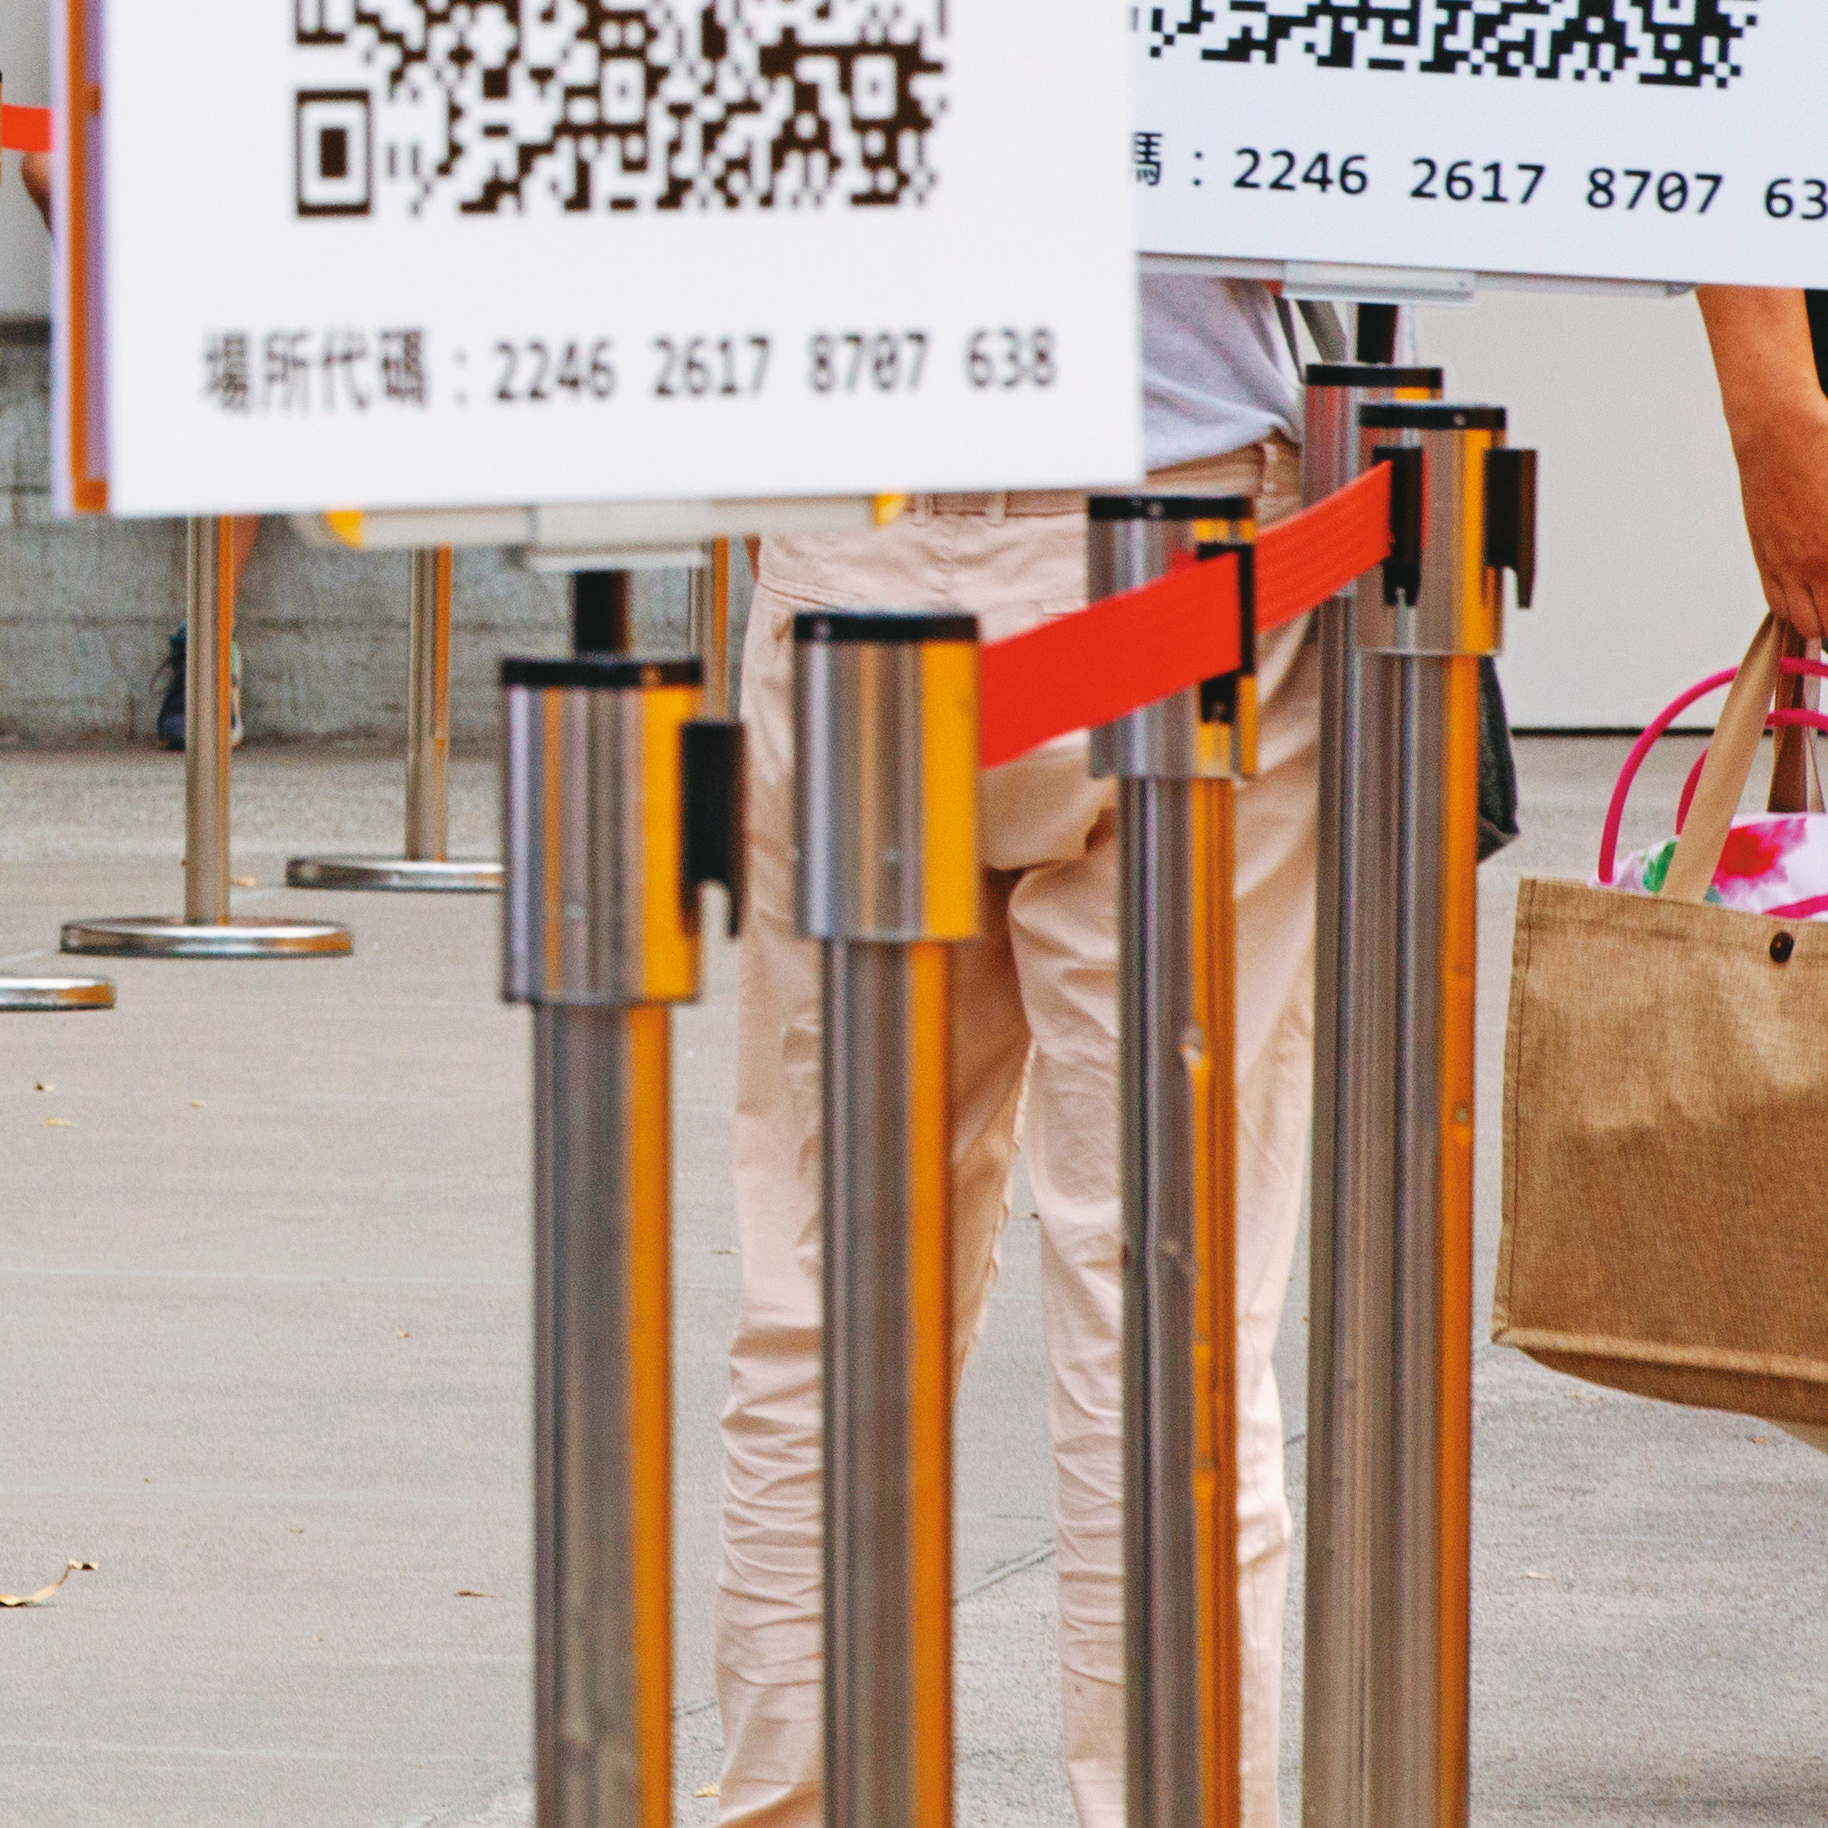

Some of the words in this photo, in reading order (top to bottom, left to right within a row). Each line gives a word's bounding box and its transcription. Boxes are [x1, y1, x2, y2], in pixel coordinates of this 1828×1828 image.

[1408, 155, 1547, 206] 2617
[1584, 165, 1725, 216] 8707
[652, 333, 773, 400] 2617
[810, 328, 931, 395] 8707
[964, 326, 1056, 390] 638
